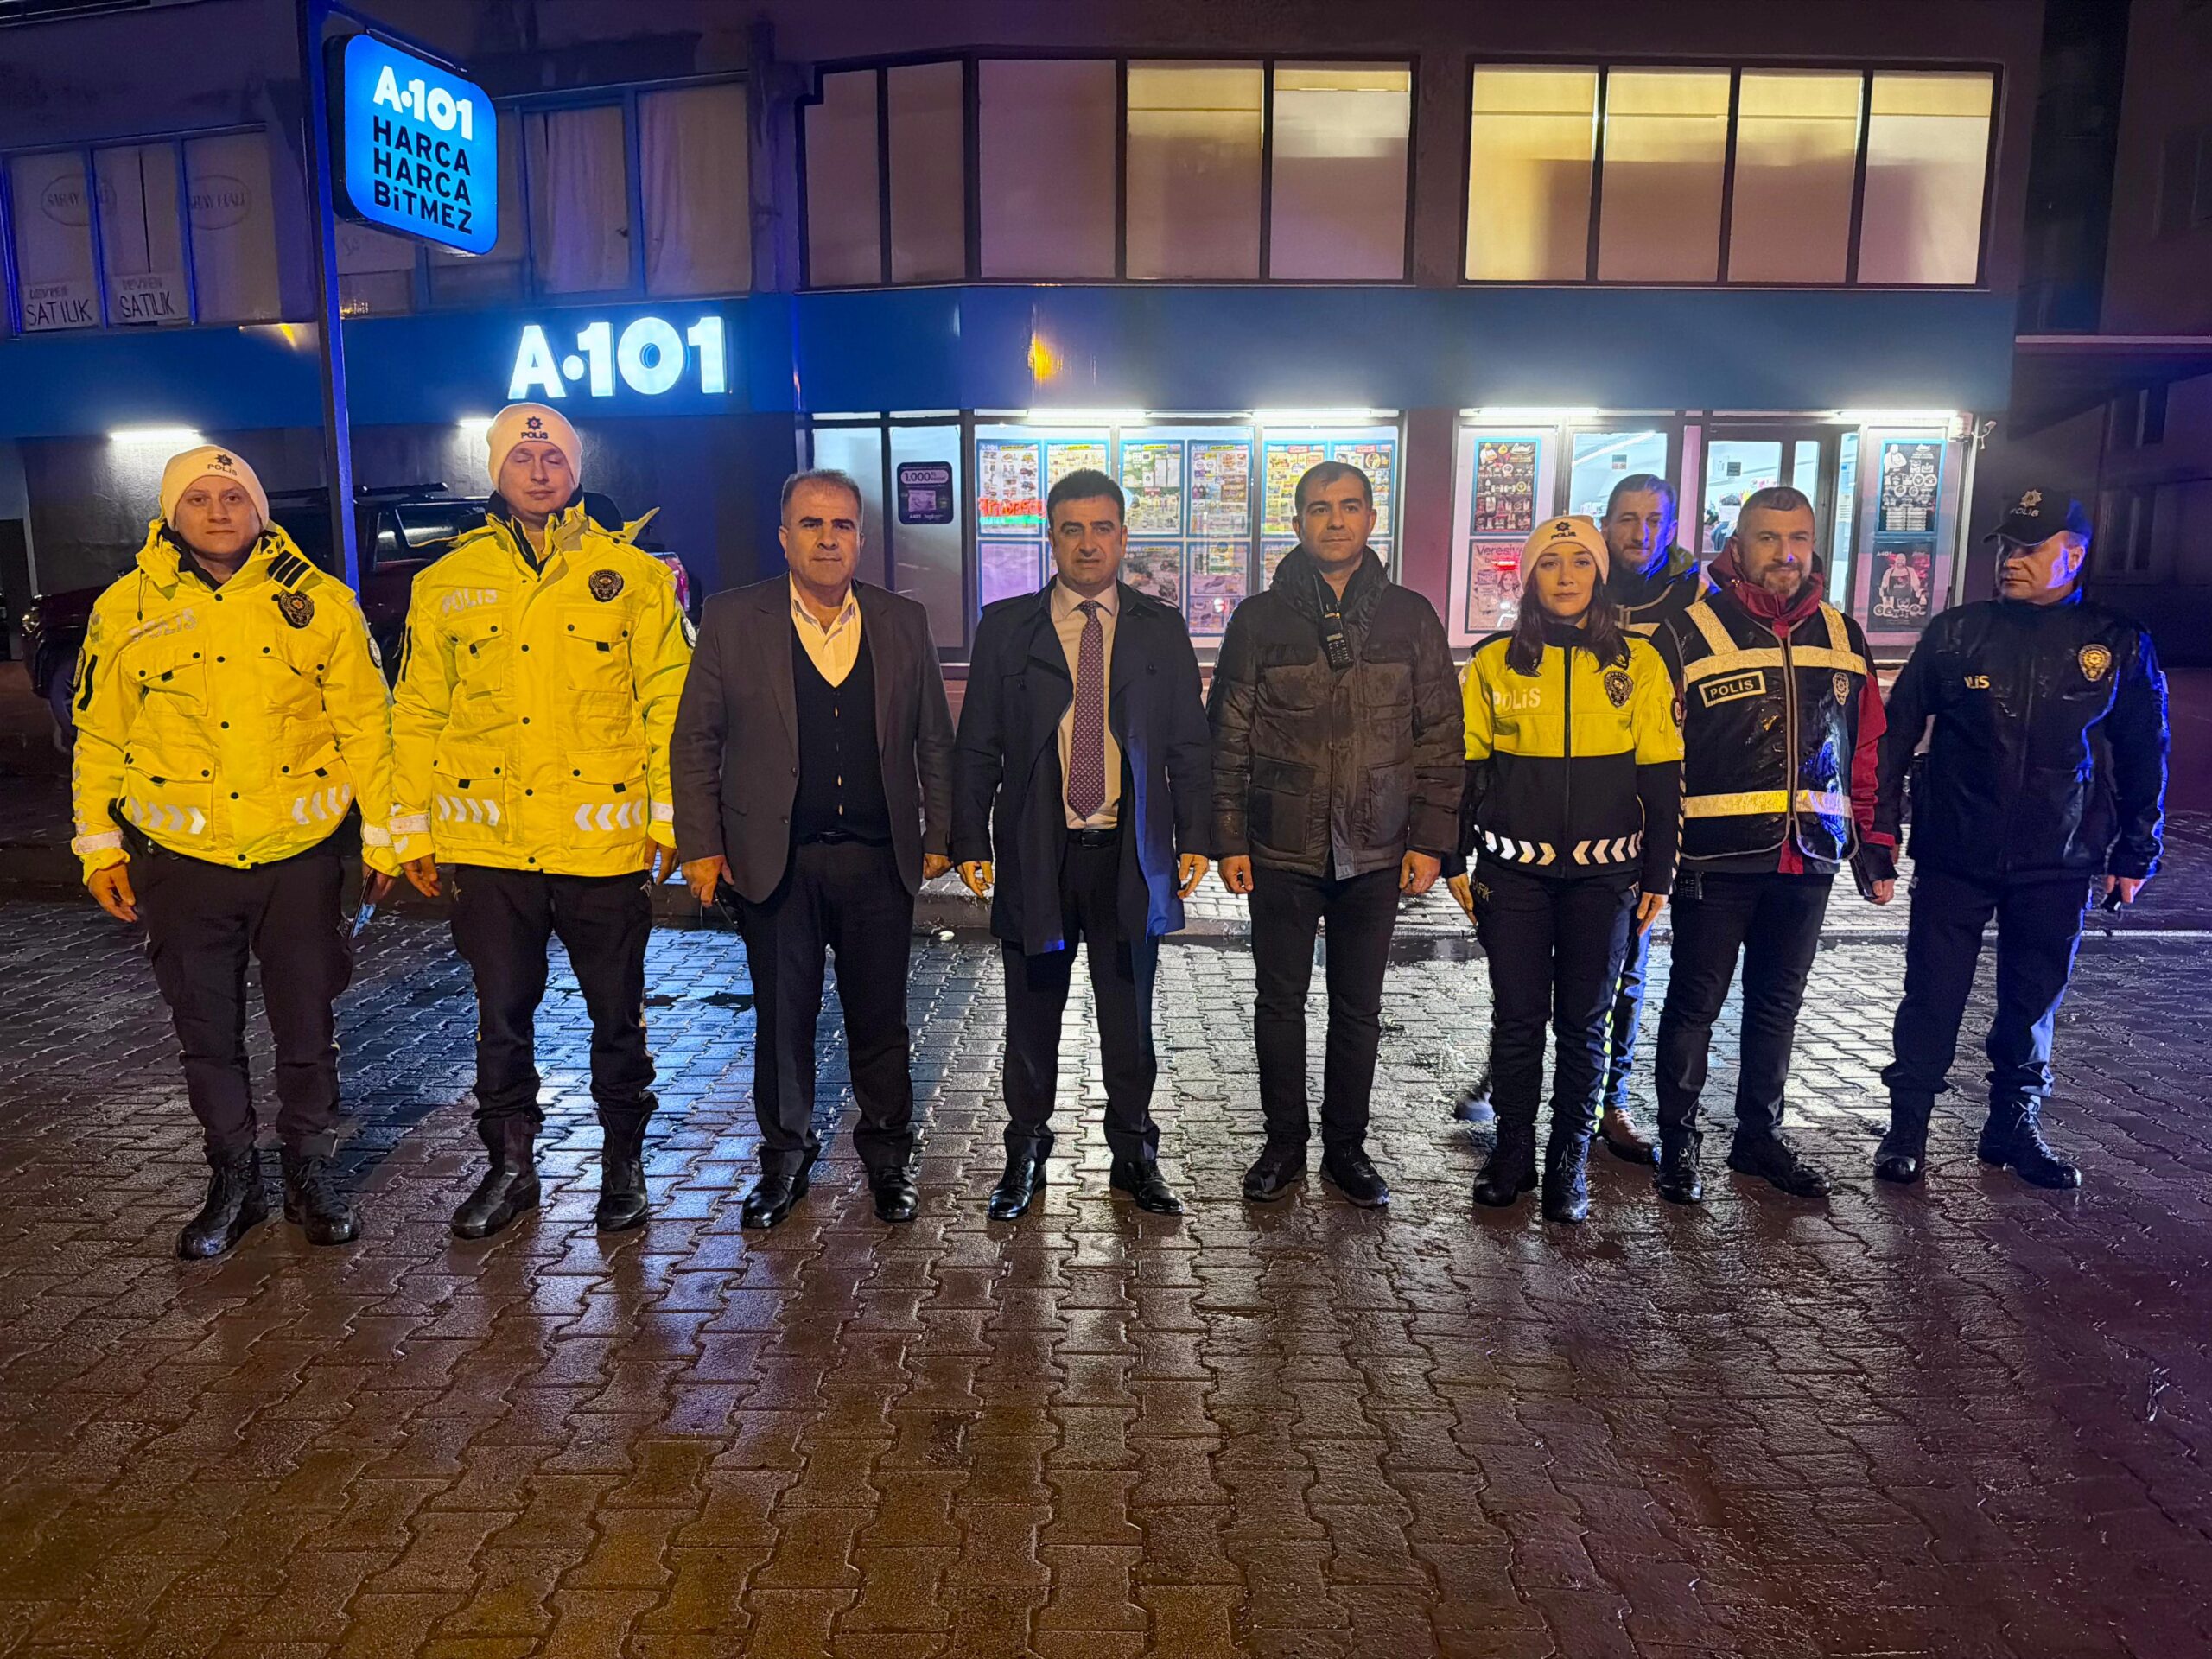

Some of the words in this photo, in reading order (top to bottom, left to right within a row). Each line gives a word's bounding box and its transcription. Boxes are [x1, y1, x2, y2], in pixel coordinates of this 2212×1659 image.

[373, 115, 471, 176] HARCA
[373, 148, 471, 206] HARCA
[26, 298, 92, 326] SATILIK
[120, 290, 175, 318] SATILIK
[904, 472, 931, 482] 1.000
